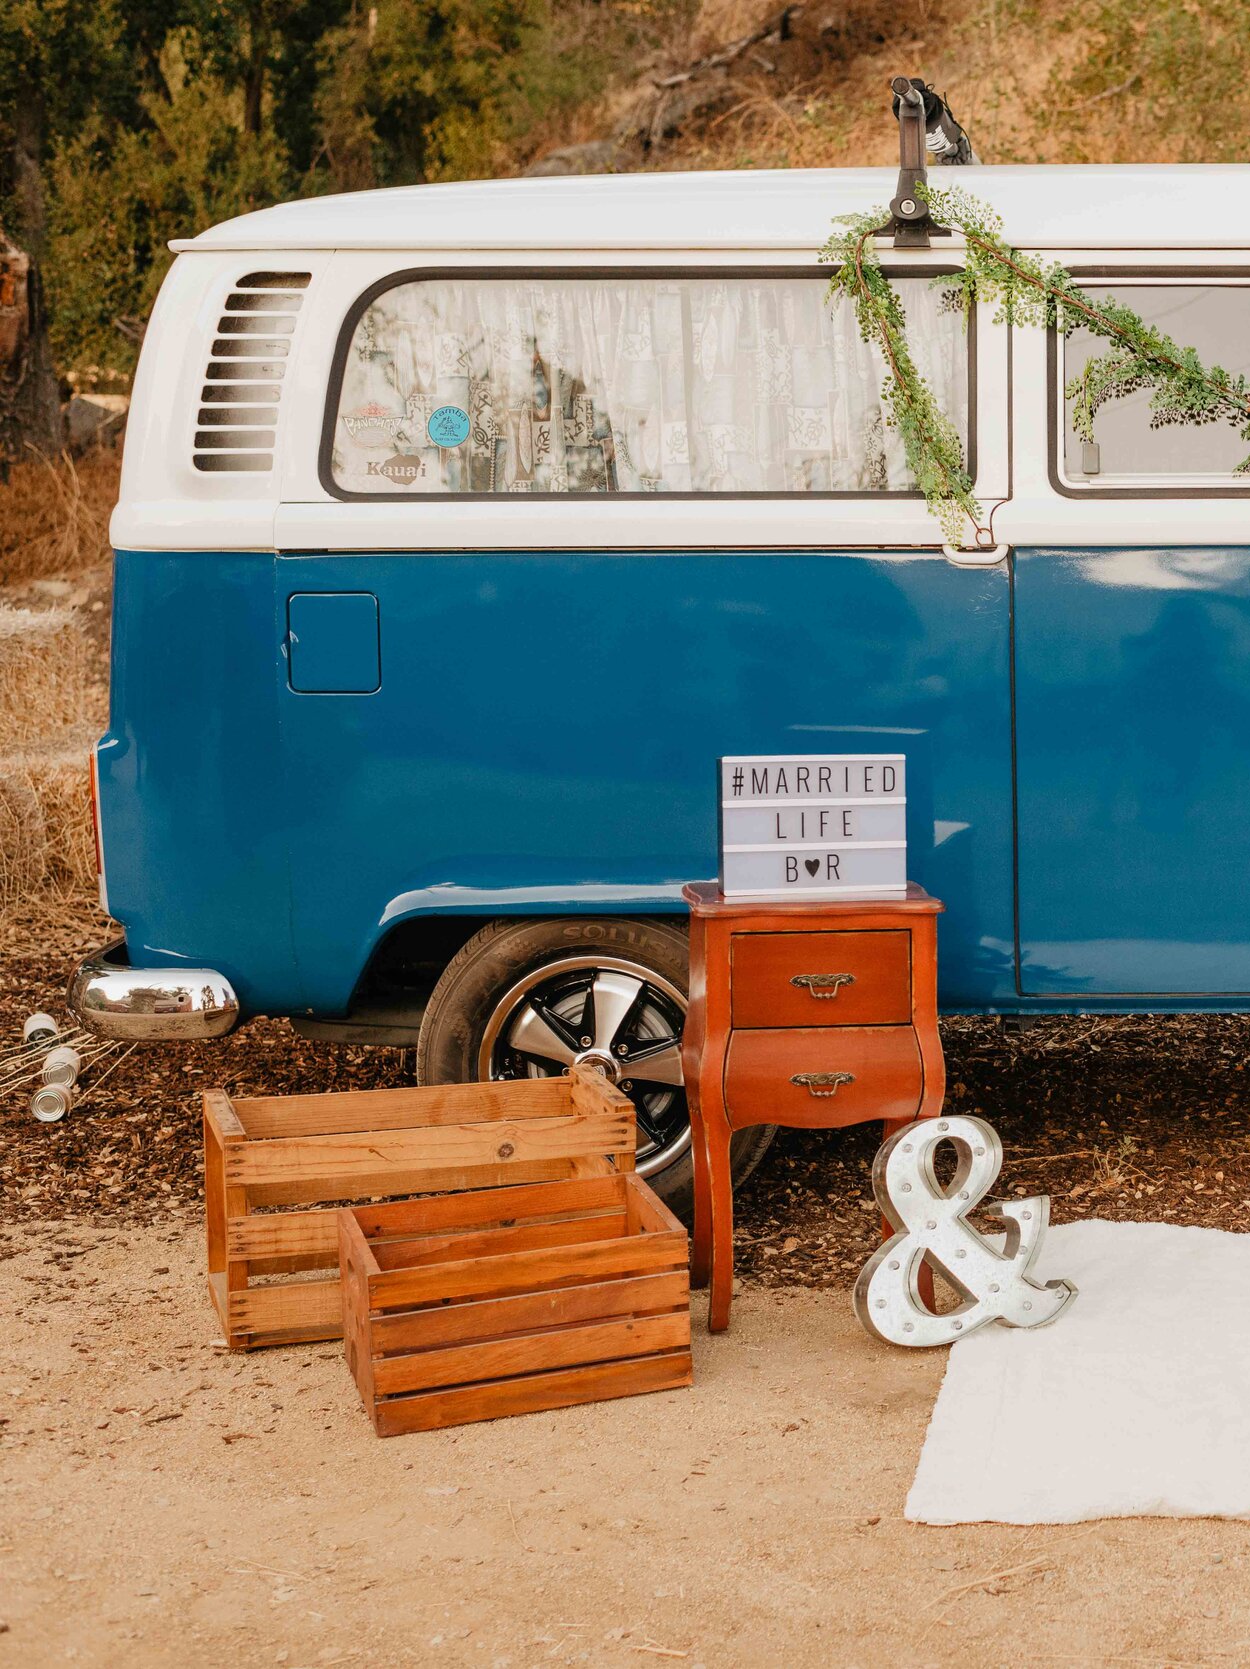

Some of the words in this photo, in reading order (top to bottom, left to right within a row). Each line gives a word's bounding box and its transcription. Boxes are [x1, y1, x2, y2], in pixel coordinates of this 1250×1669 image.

[432, 408, 467, 422] Tamba
[732, 766, 896, 796] #MARRIED
[776, 810, 853, 839] LIFE
